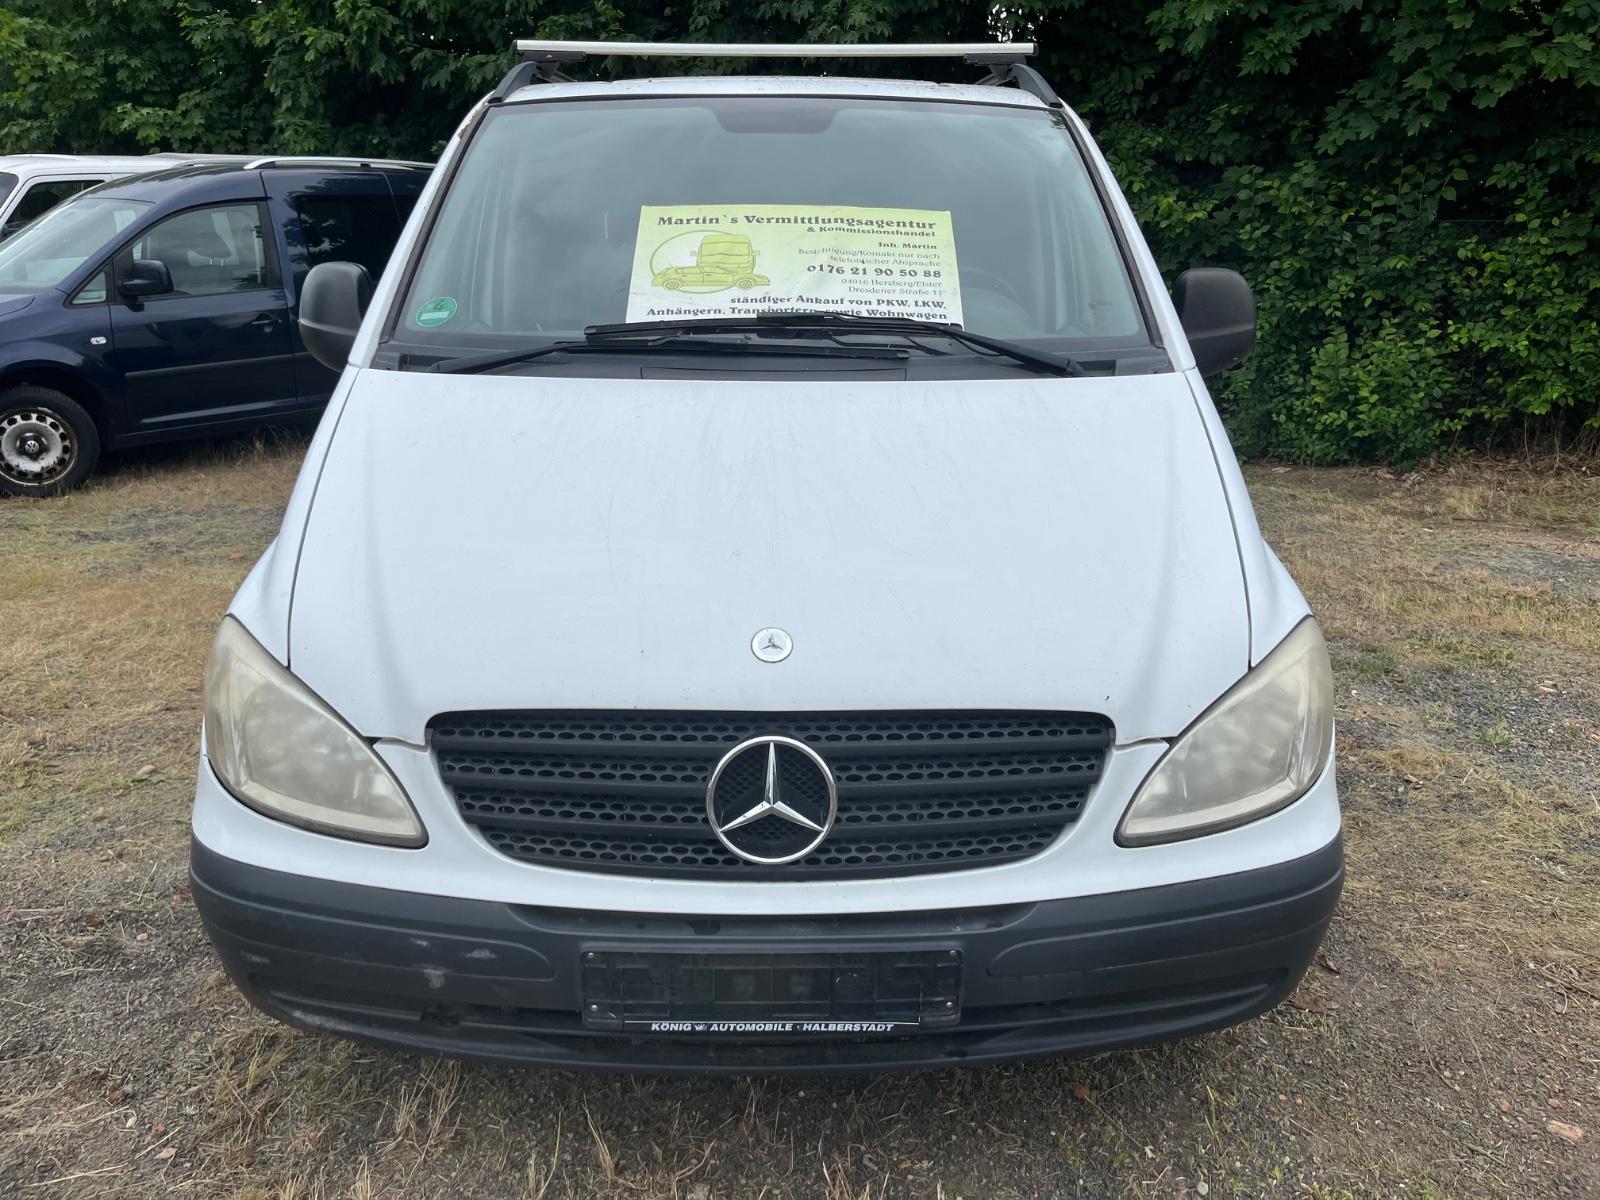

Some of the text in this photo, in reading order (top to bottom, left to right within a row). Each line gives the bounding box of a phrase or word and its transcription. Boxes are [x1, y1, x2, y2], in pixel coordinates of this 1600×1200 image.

[744, 215, 936, 229] Vermittlungsagentur
[820, 226, 935, 237] Kommissionshandel
[893, 259, 941, 267] Absprache
[807, 264, 942, 278] 0176 21 90 50 88
[848, 286, 896, 294] Dresdener
[730, 295, 792, 304] ständiger
[796, 295, 844, 305] Ankauf
[866, 309, 948, 320] Wohnwagen
[651, 1022, 894, 1032] KÖNIG AUTOMOBILE HALBERSTADT
